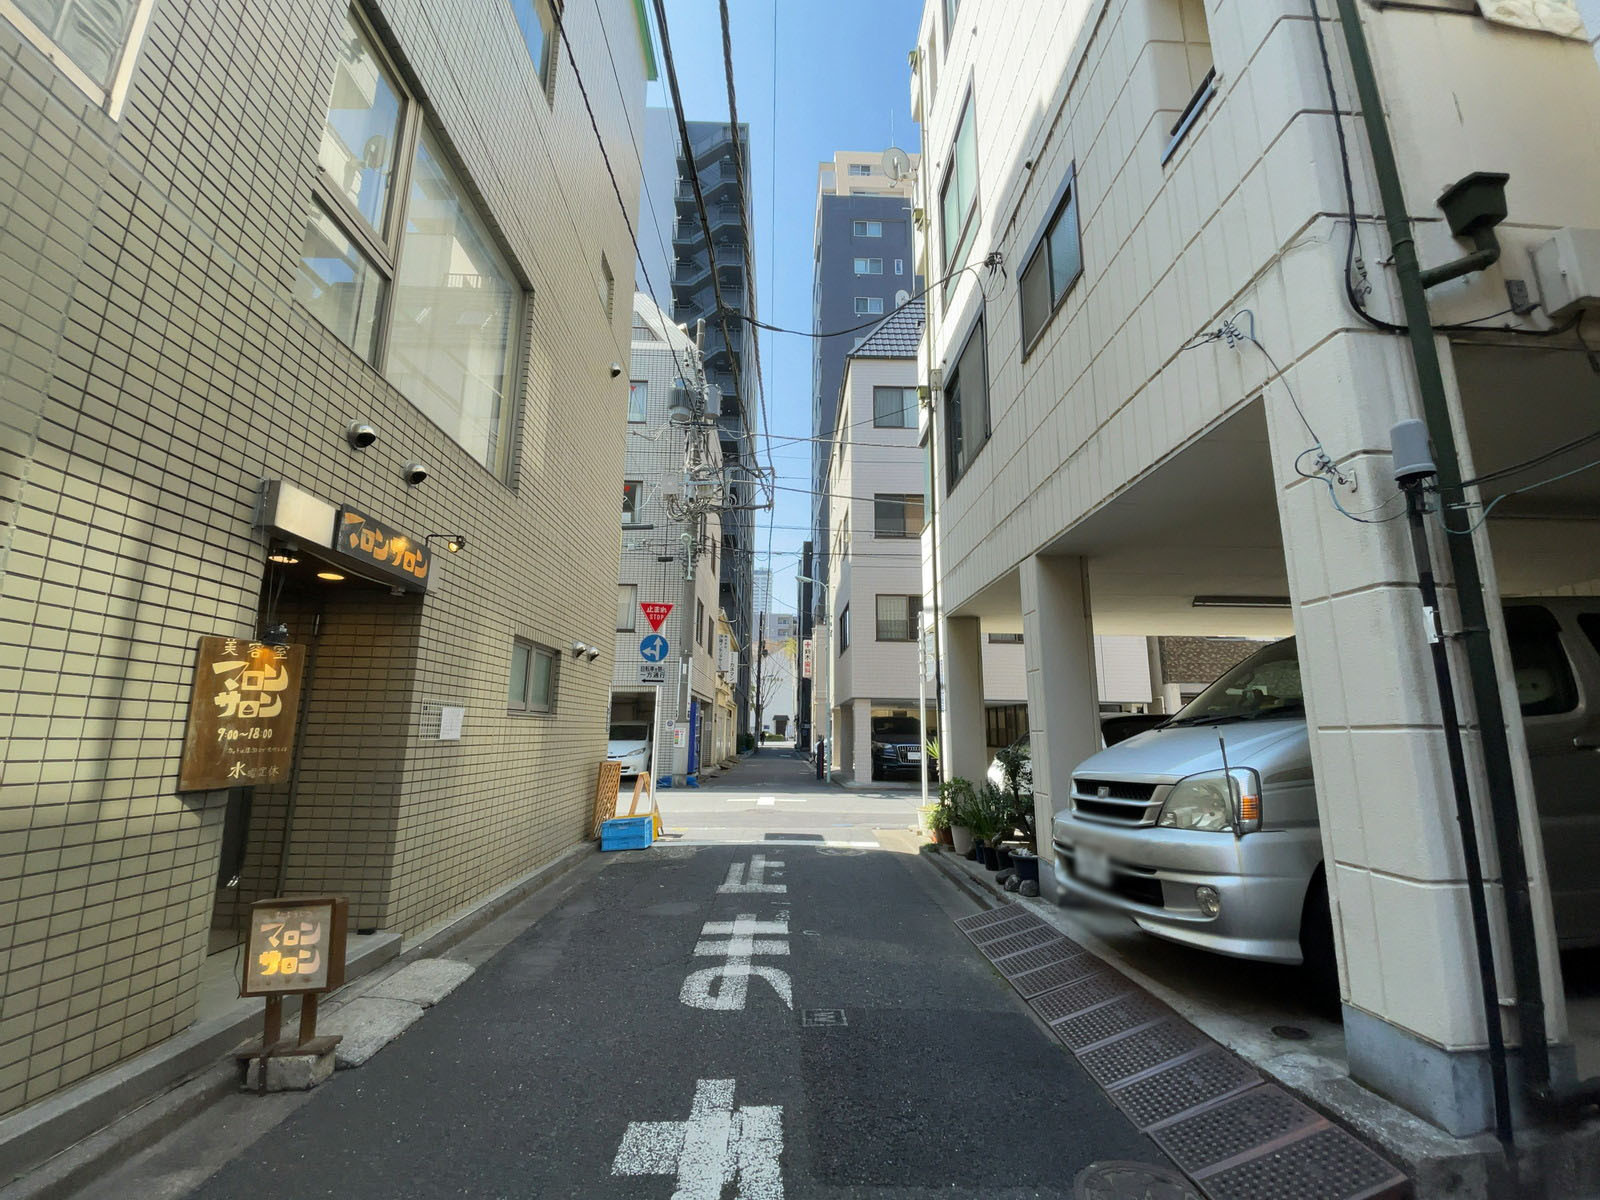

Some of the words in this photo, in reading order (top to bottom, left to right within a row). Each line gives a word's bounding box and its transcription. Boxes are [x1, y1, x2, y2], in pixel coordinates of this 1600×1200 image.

[344, 512, 428, 579] マロンサロン
[220, 639, 290, 661] 美容室
[212, 660, 289, 692] マロン
[640, 671, 665, 679] 一方通行
[213, 690, 282, 719] サロン
[260, 921, 321, 948] マロン
[258, 949, 321, 976] サロン
